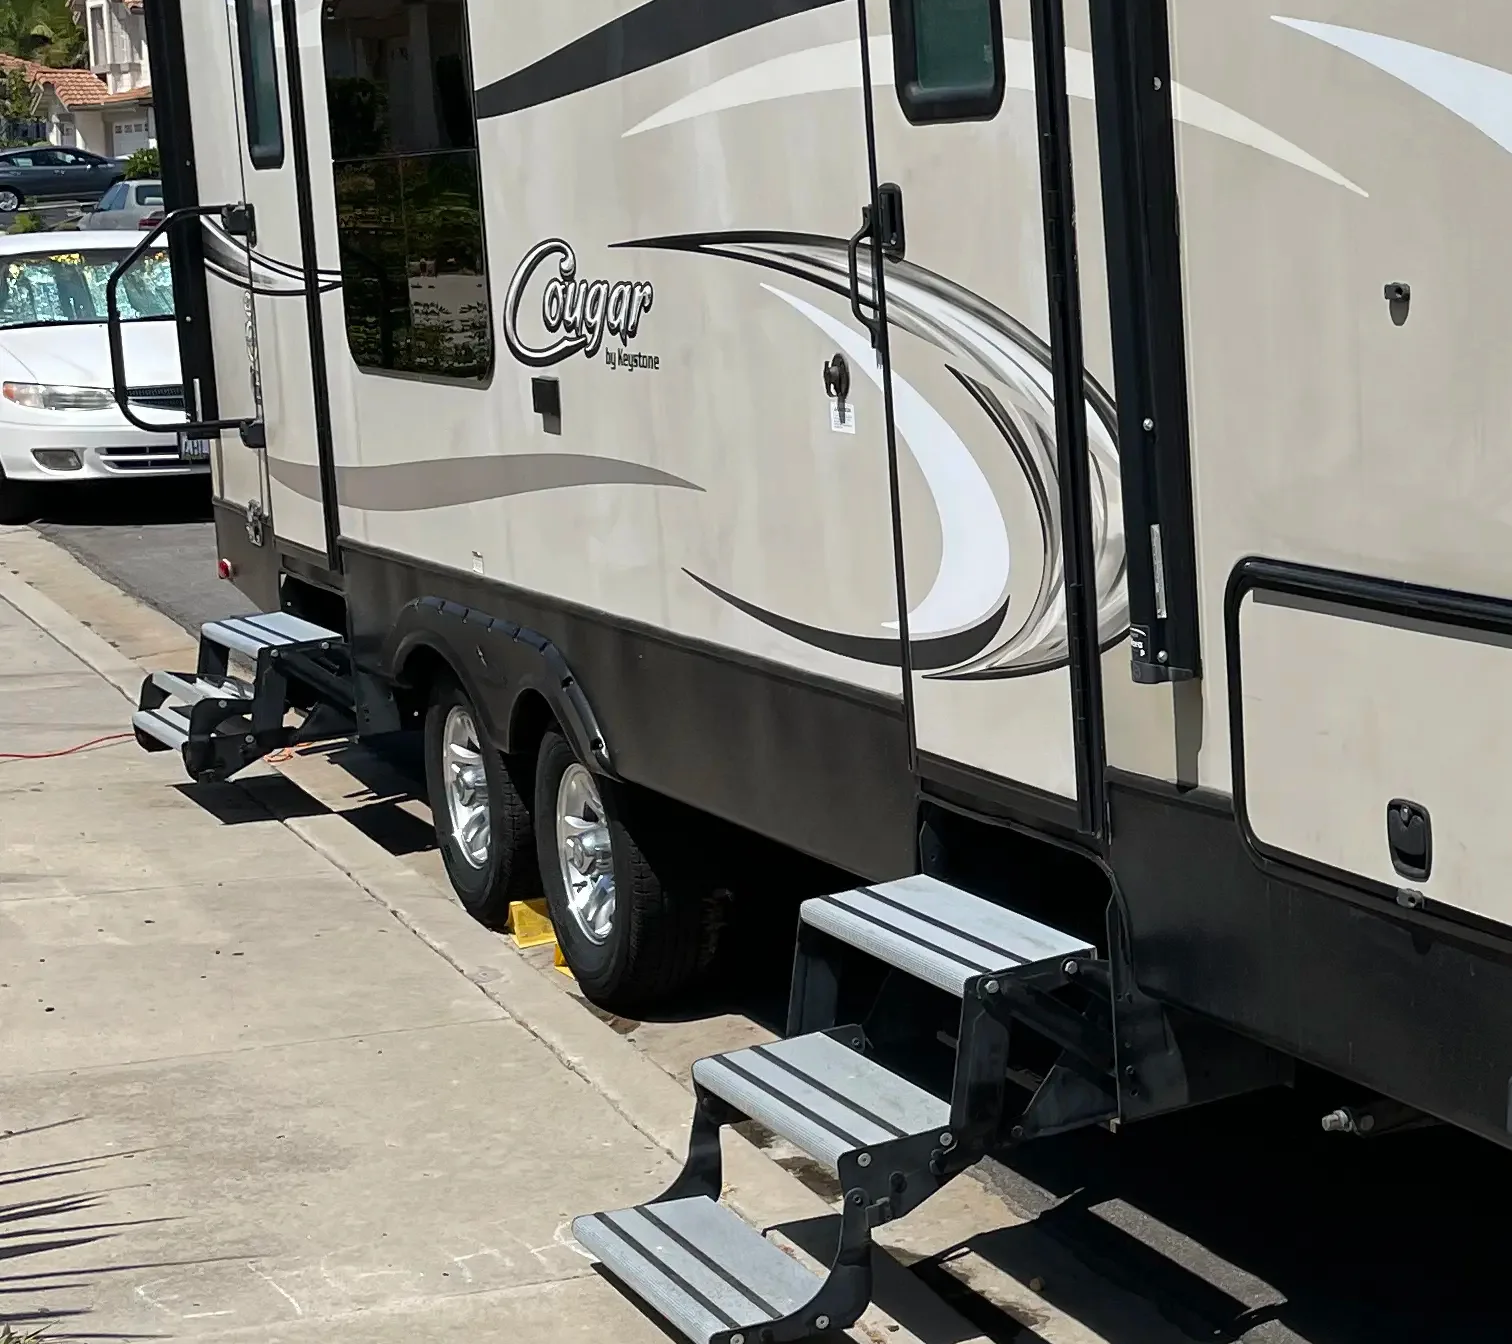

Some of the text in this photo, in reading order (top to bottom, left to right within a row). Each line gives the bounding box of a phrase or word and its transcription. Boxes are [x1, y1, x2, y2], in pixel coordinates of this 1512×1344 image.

[504, 238, 653, 367] Cougar
[605, 347, 660, 371] by Keystone
